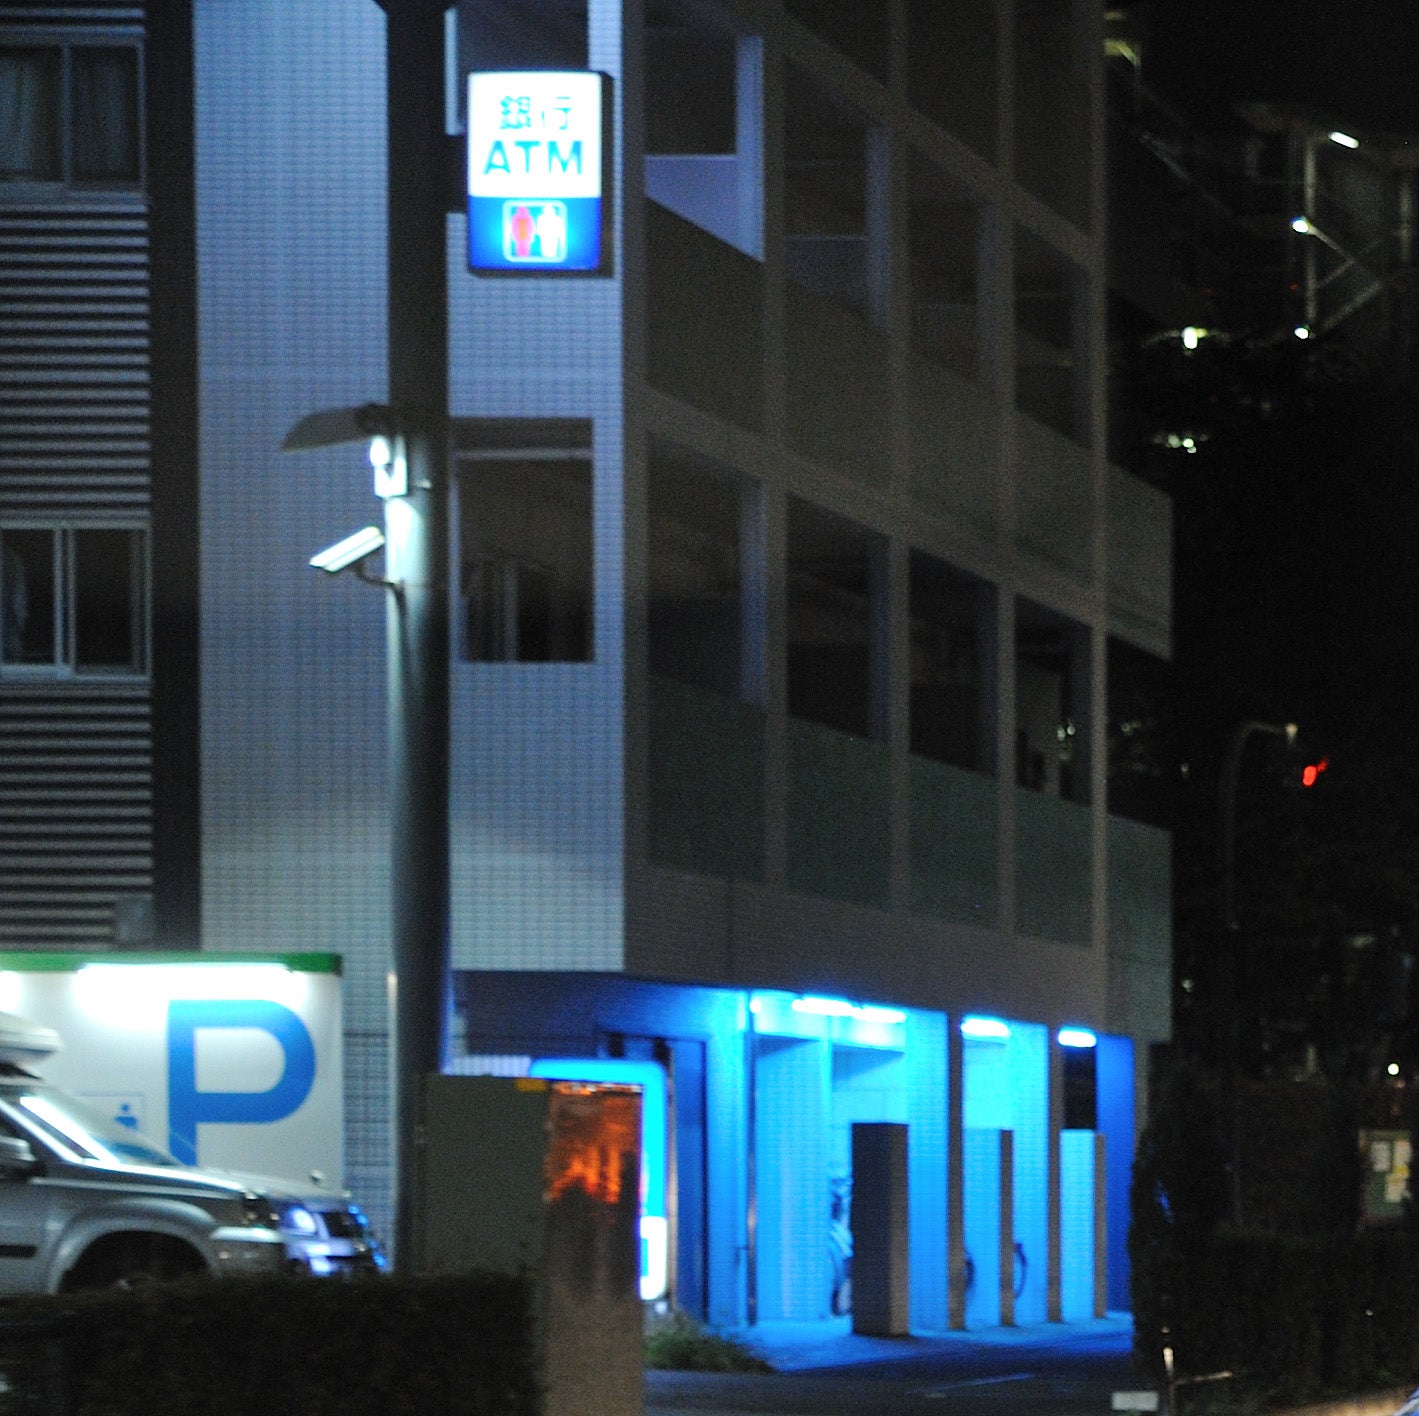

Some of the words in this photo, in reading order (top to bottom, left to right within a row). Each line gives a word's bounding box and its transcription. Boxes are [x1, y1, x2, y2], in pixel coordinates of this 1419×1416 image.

[500, 96, 571, 131] 銀行
[484, 141, 582, 175] ATM
[168, 999, 316, 1166] P
